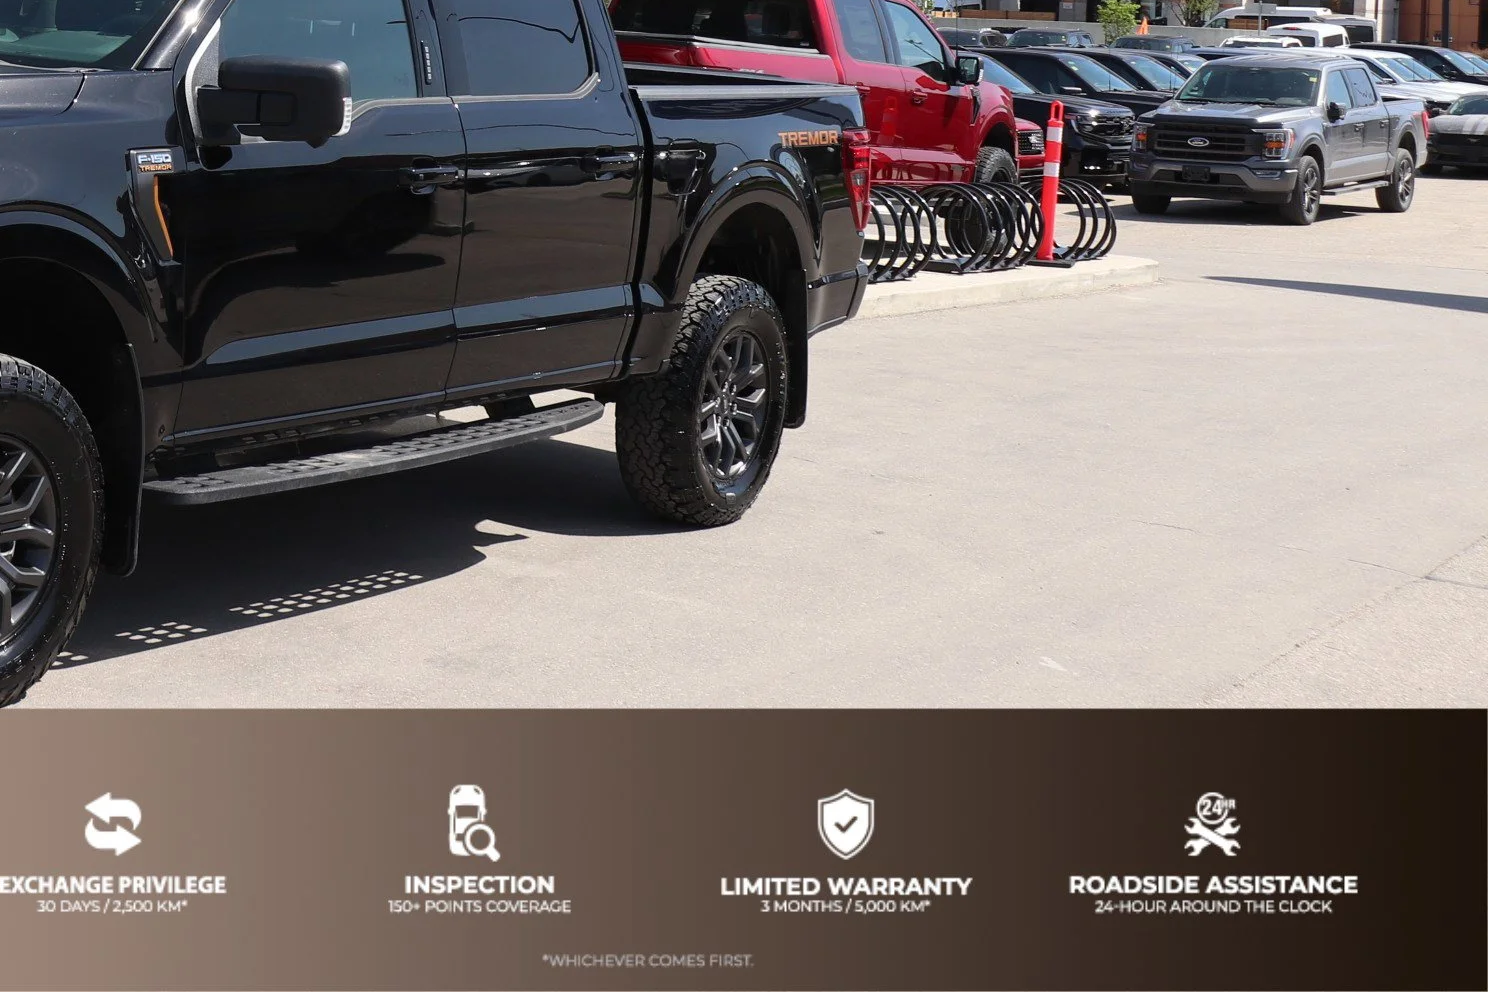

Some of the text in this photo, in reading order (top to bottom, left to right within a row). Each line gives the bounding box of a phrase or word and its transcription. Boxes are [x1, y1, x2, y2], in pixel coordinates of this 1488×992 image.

[778, 130, 839, 148] TREMOR
[138, 153, 172, 164] F-150
[138, 163, 172, 173] TREMOR
